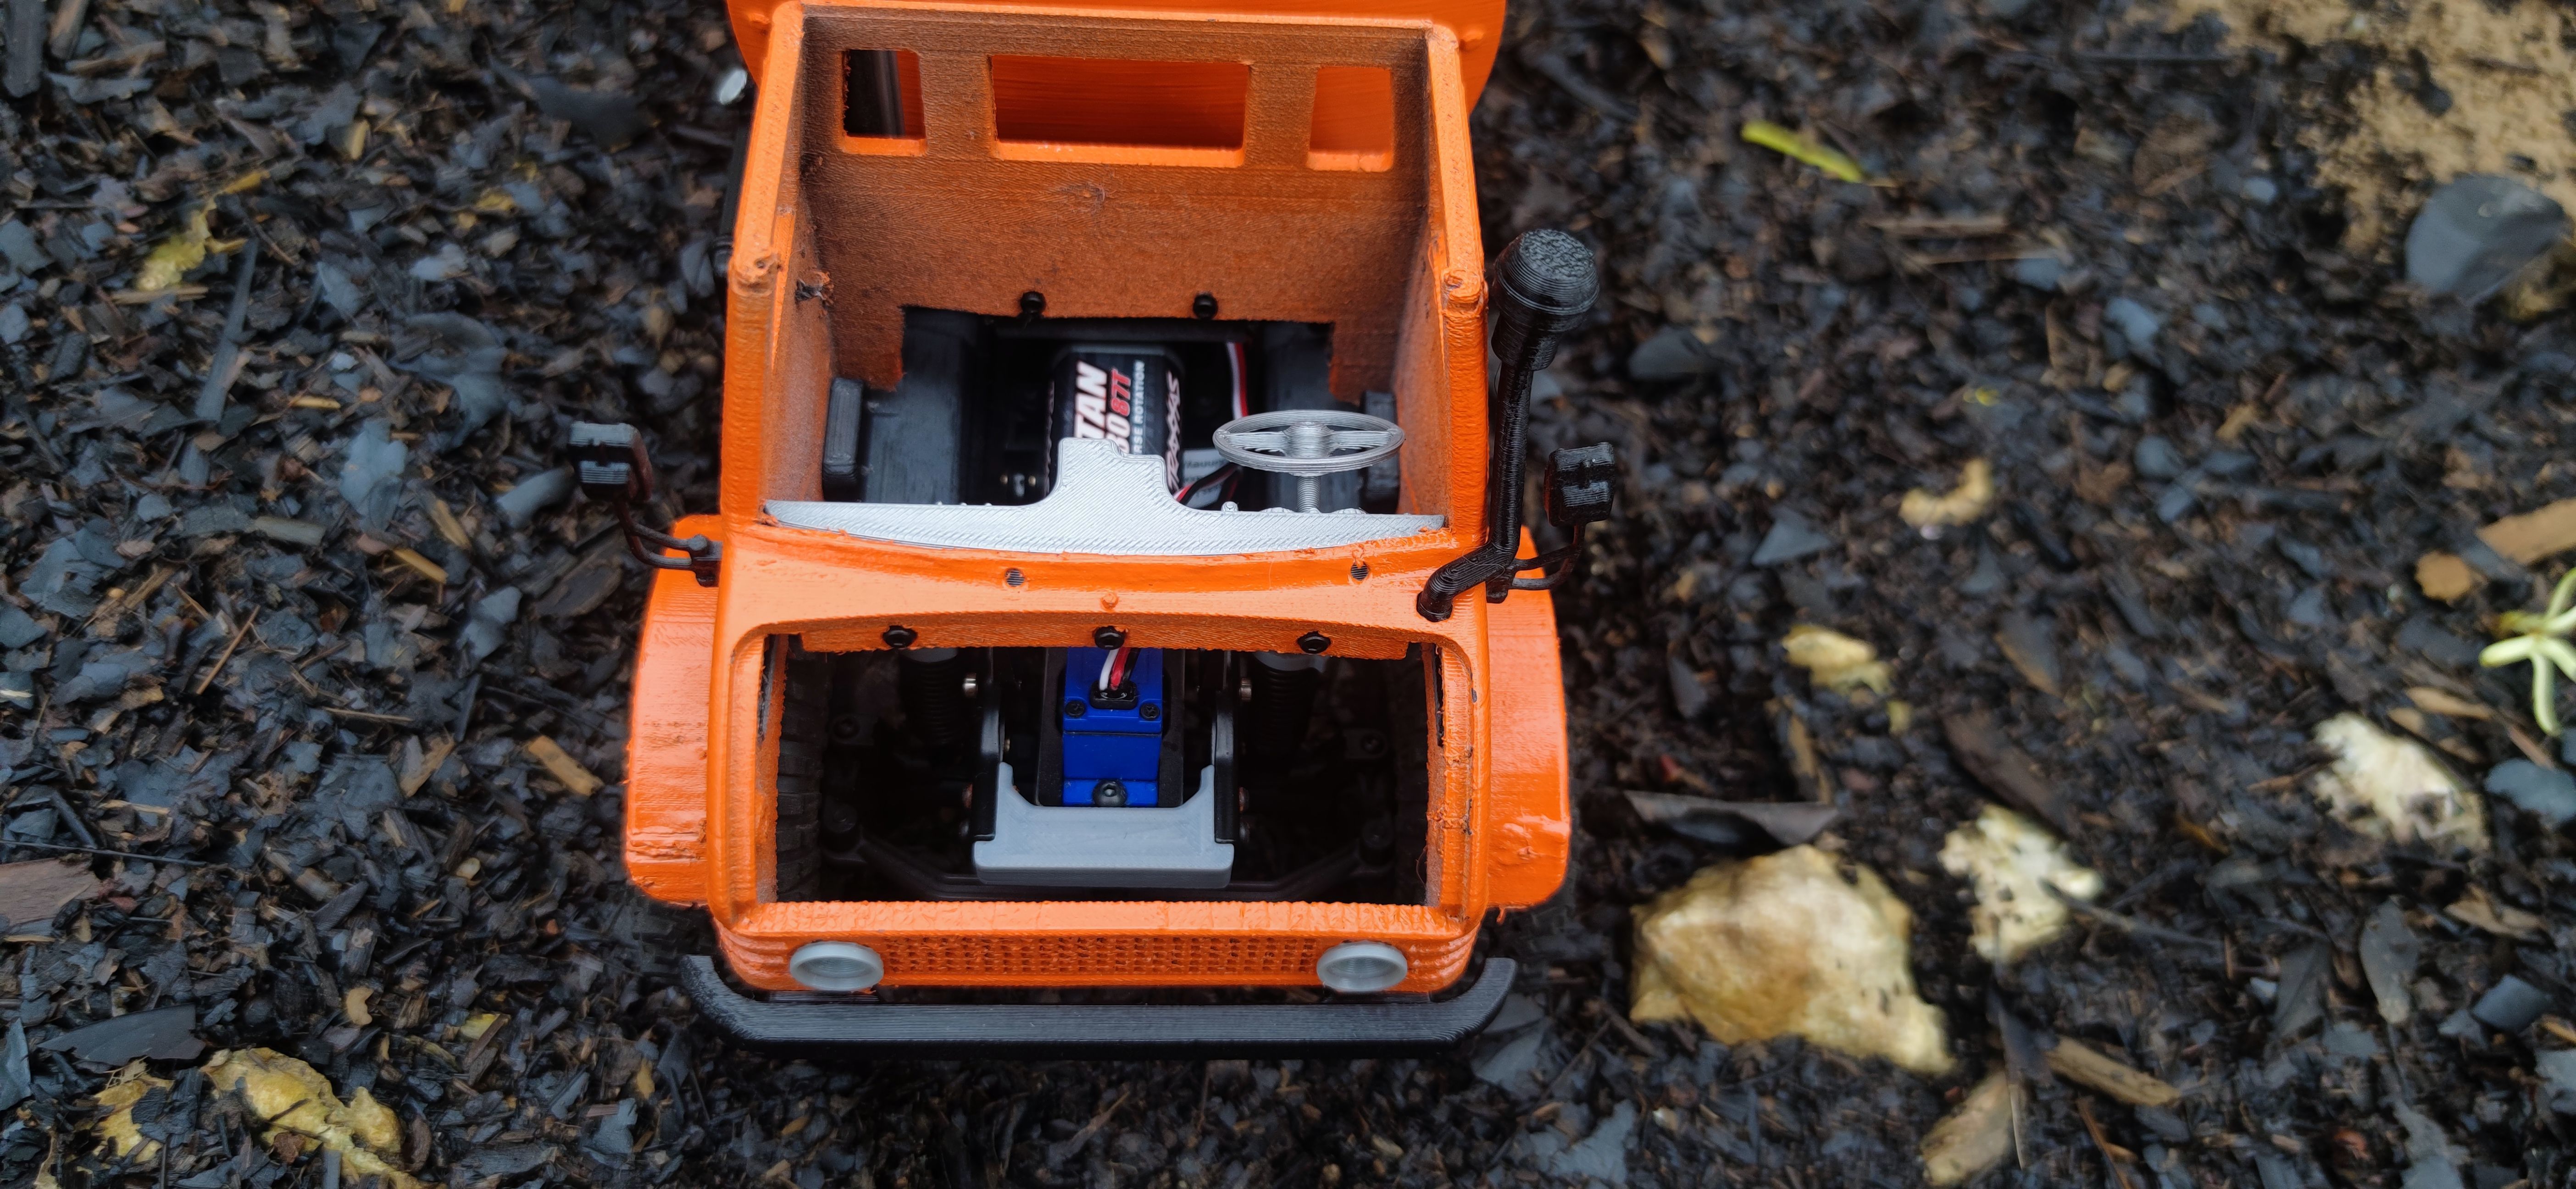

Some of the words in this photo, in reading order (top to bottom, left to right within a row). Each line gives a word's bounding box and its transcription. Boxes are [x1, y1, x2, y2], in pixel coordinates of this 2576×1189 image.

[1110, 368, 1131, 417] 87T
[1133, 360, 1145, 424] ROTATION
[1166, 371, 1181, 494] TRAXXAS
